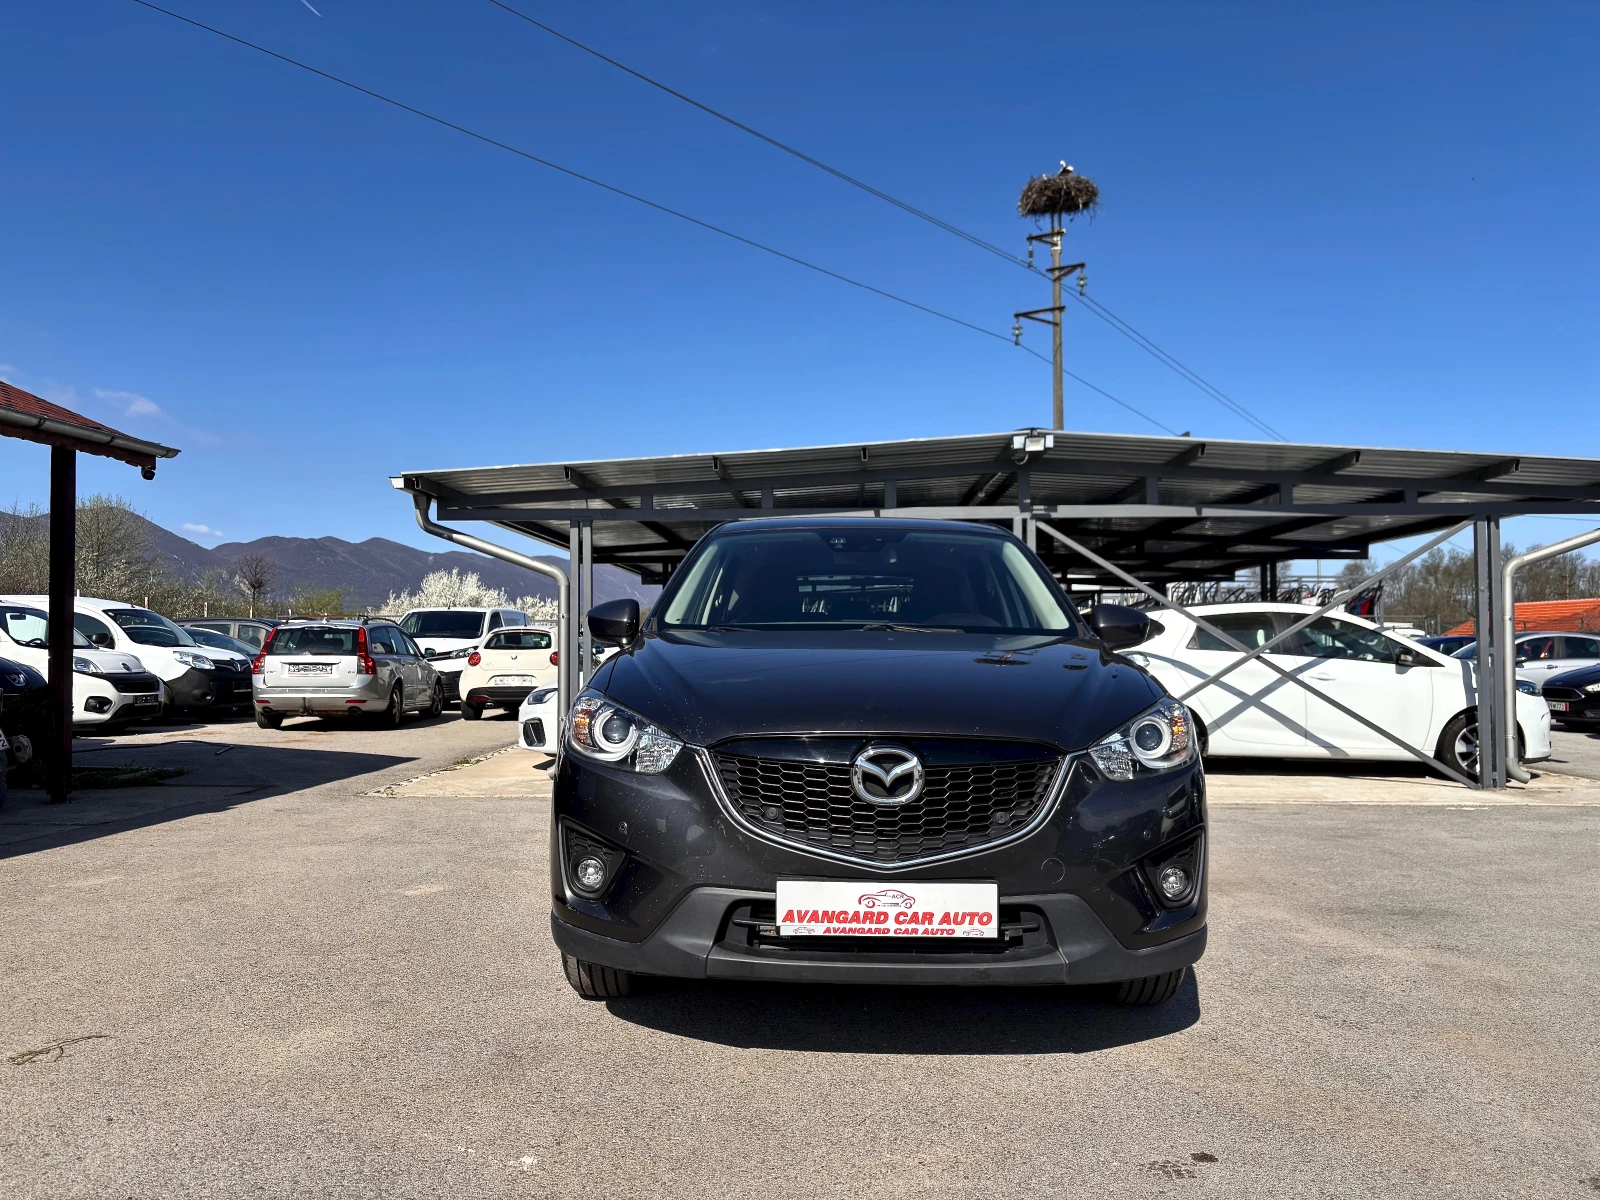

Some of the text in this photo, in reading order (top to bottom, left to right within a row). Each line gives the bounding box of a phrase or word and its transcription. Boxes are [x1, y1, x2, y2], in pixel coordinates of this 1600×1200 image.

[781, 909, 993, 926] AVANGARD CAR AUTO
[823, 926, 956, 936] AVANGARD CAR AUTO
